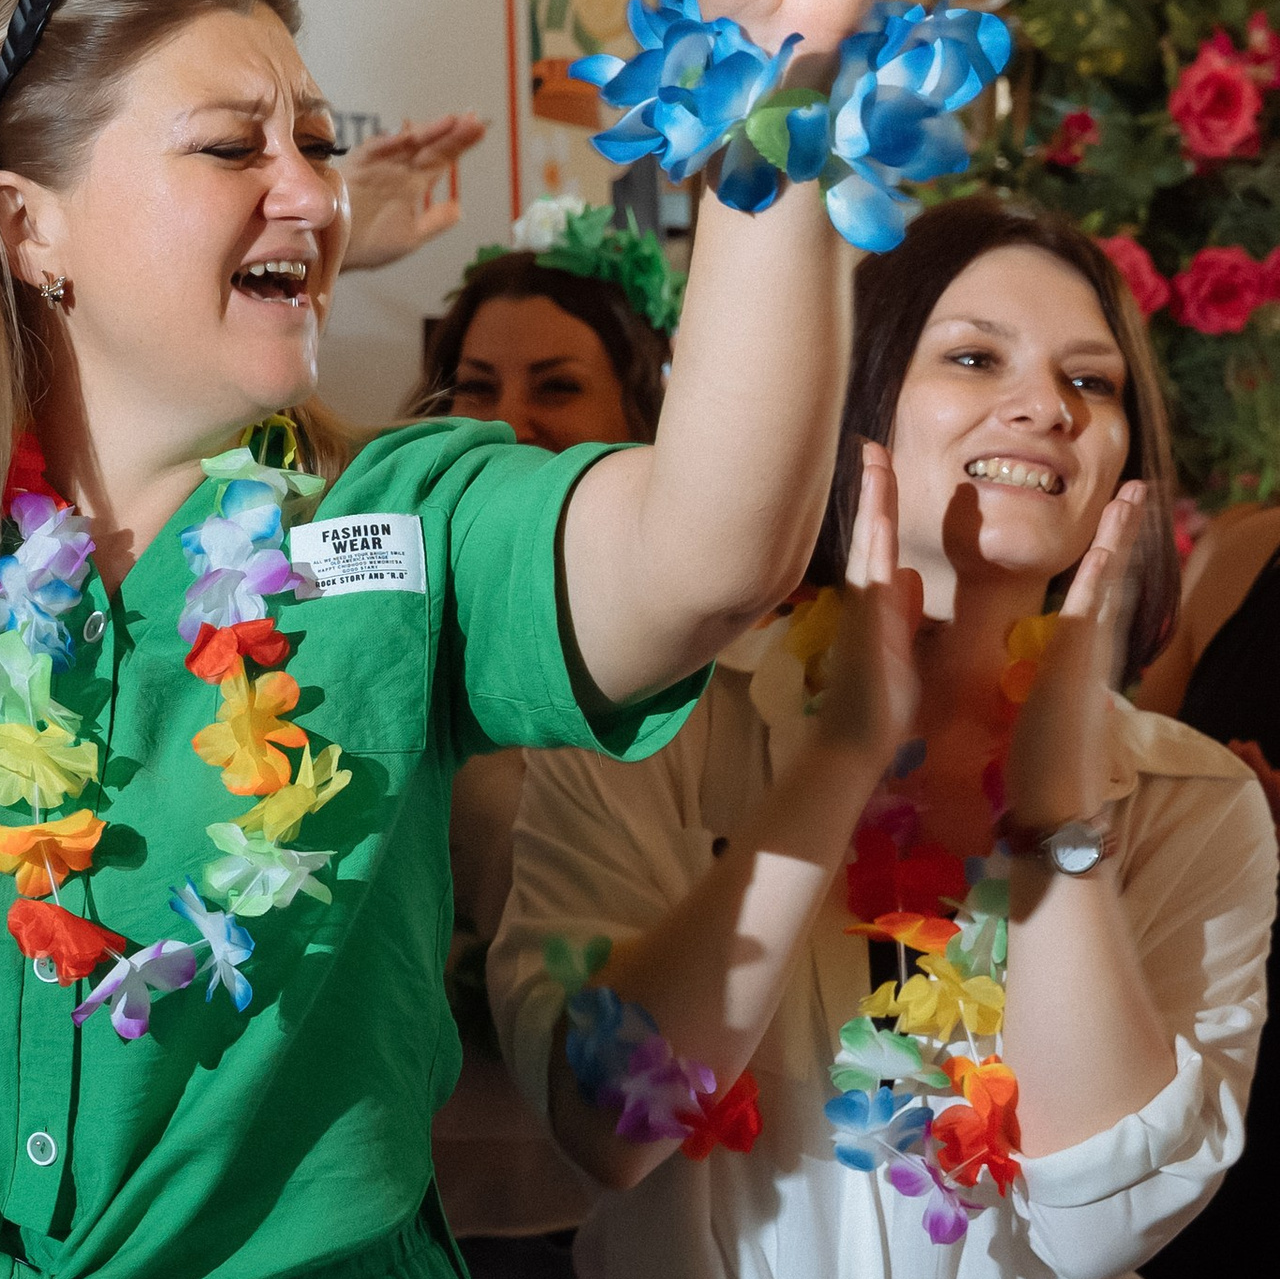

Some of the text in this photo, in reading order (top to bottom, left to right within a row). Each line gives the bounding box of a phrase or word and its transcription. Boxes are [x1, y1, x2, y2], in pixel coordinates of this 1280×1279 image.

[322, 523, 391, 543] FASHION
[332, 537, 382, 554] WEAR
[315, 579, 337, 588] ROCK
[339, 573, 366, 584] STORY
[368, 572, 385, 580] AND
